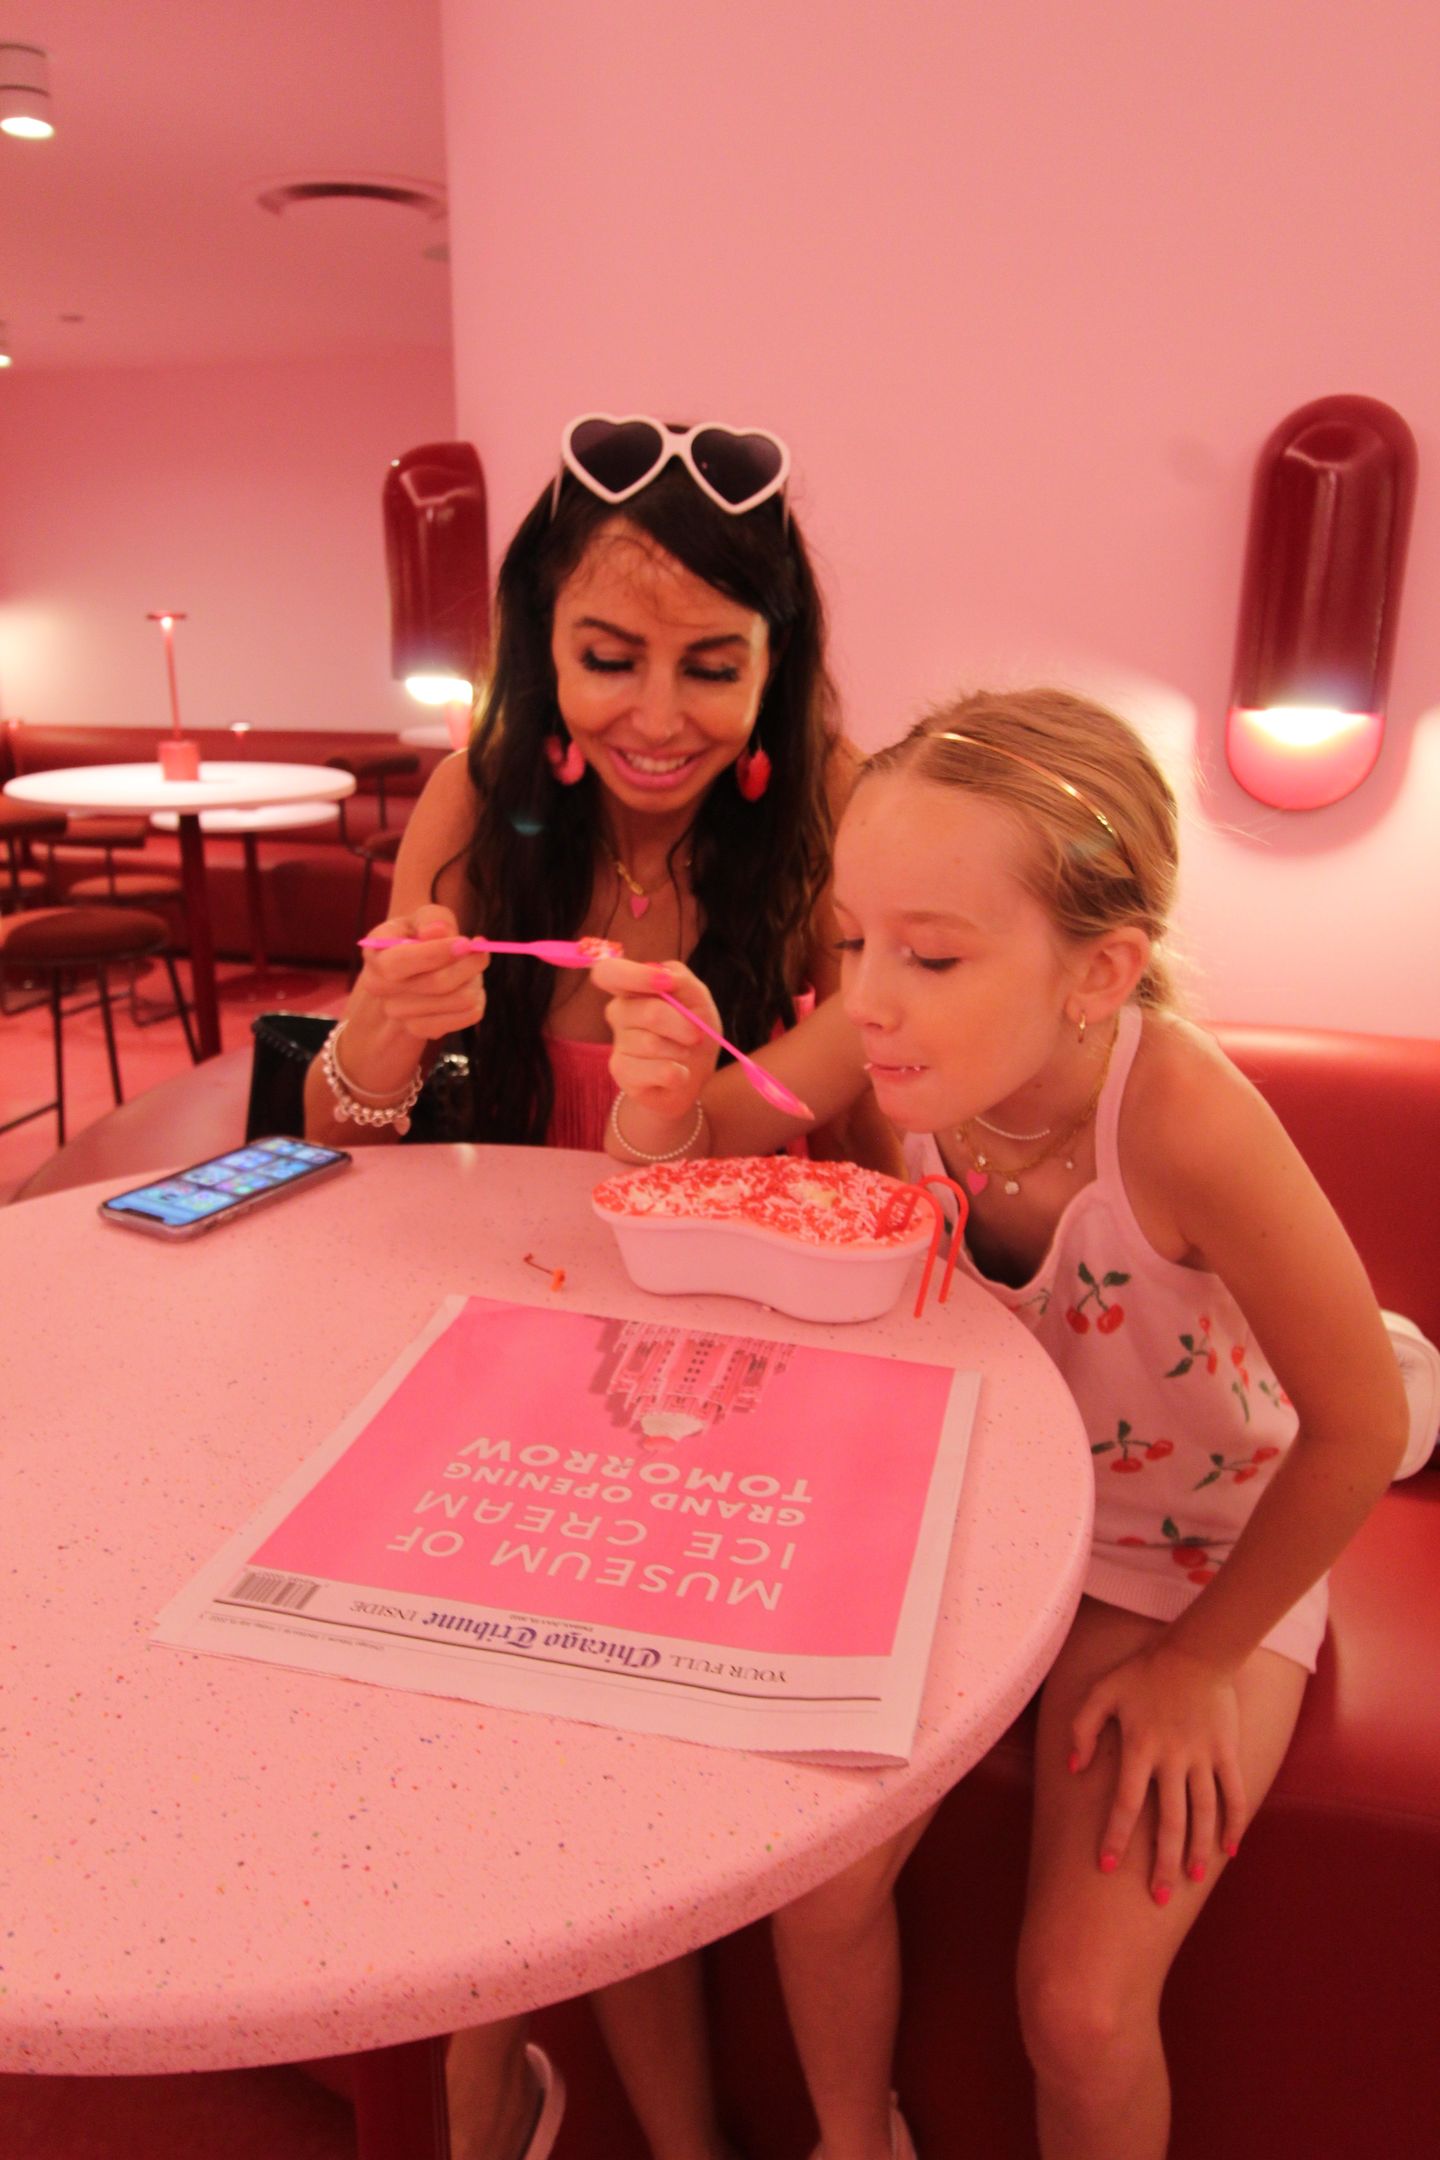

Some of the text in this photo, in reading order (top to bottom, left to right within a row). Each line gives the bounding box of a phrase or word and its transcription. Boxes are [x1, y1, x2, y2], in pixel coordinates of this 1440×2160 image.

[456, 1437, 813, 1503] TOMORROW
[442, 1461, 806, 1527] GRAND OPENING
[412, 1489, 797, 1570] ICE CREAM
[386, 1526, 782, 1611] MUSEUM OF
[349, 1600, 418, 1622] INSIDE
[422, 1611, 538, 1649] Tribune
[544, 1631, 662, 1669] Chicago
[669, 1654, 724, 1675] FULL
[729, 1665, 787, 1683] YOUR
